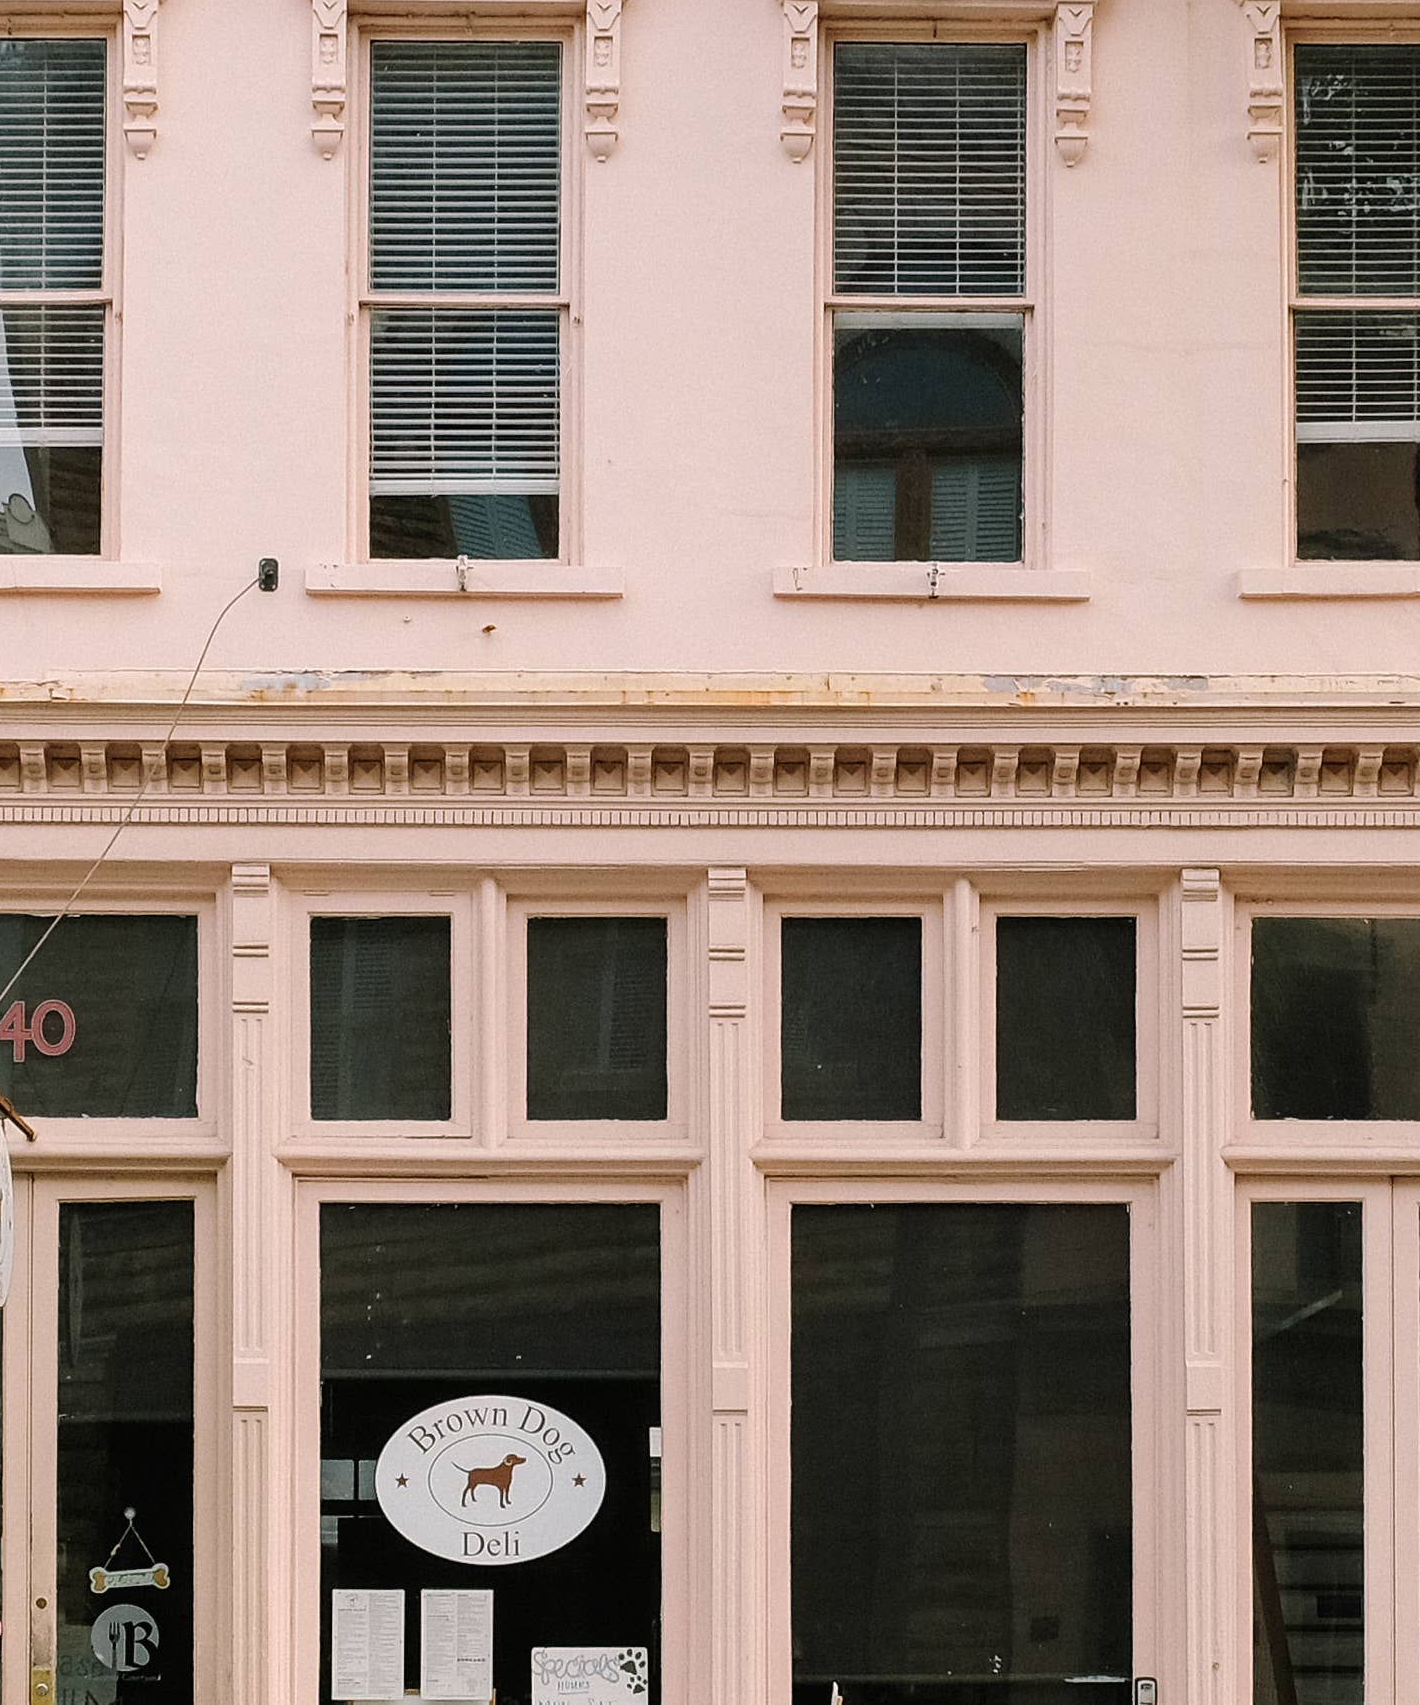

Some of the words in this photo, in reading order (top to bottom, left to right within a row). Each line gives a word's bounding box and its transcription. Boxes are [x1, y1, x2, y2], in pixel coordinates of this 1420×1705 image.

[407, 1406, 508, 1454] Brown
[518, 1405, 576, 1465] Dog
[462, 1531, 520, 1557] Deli
[533, 1650, 620, 1686] Specials
